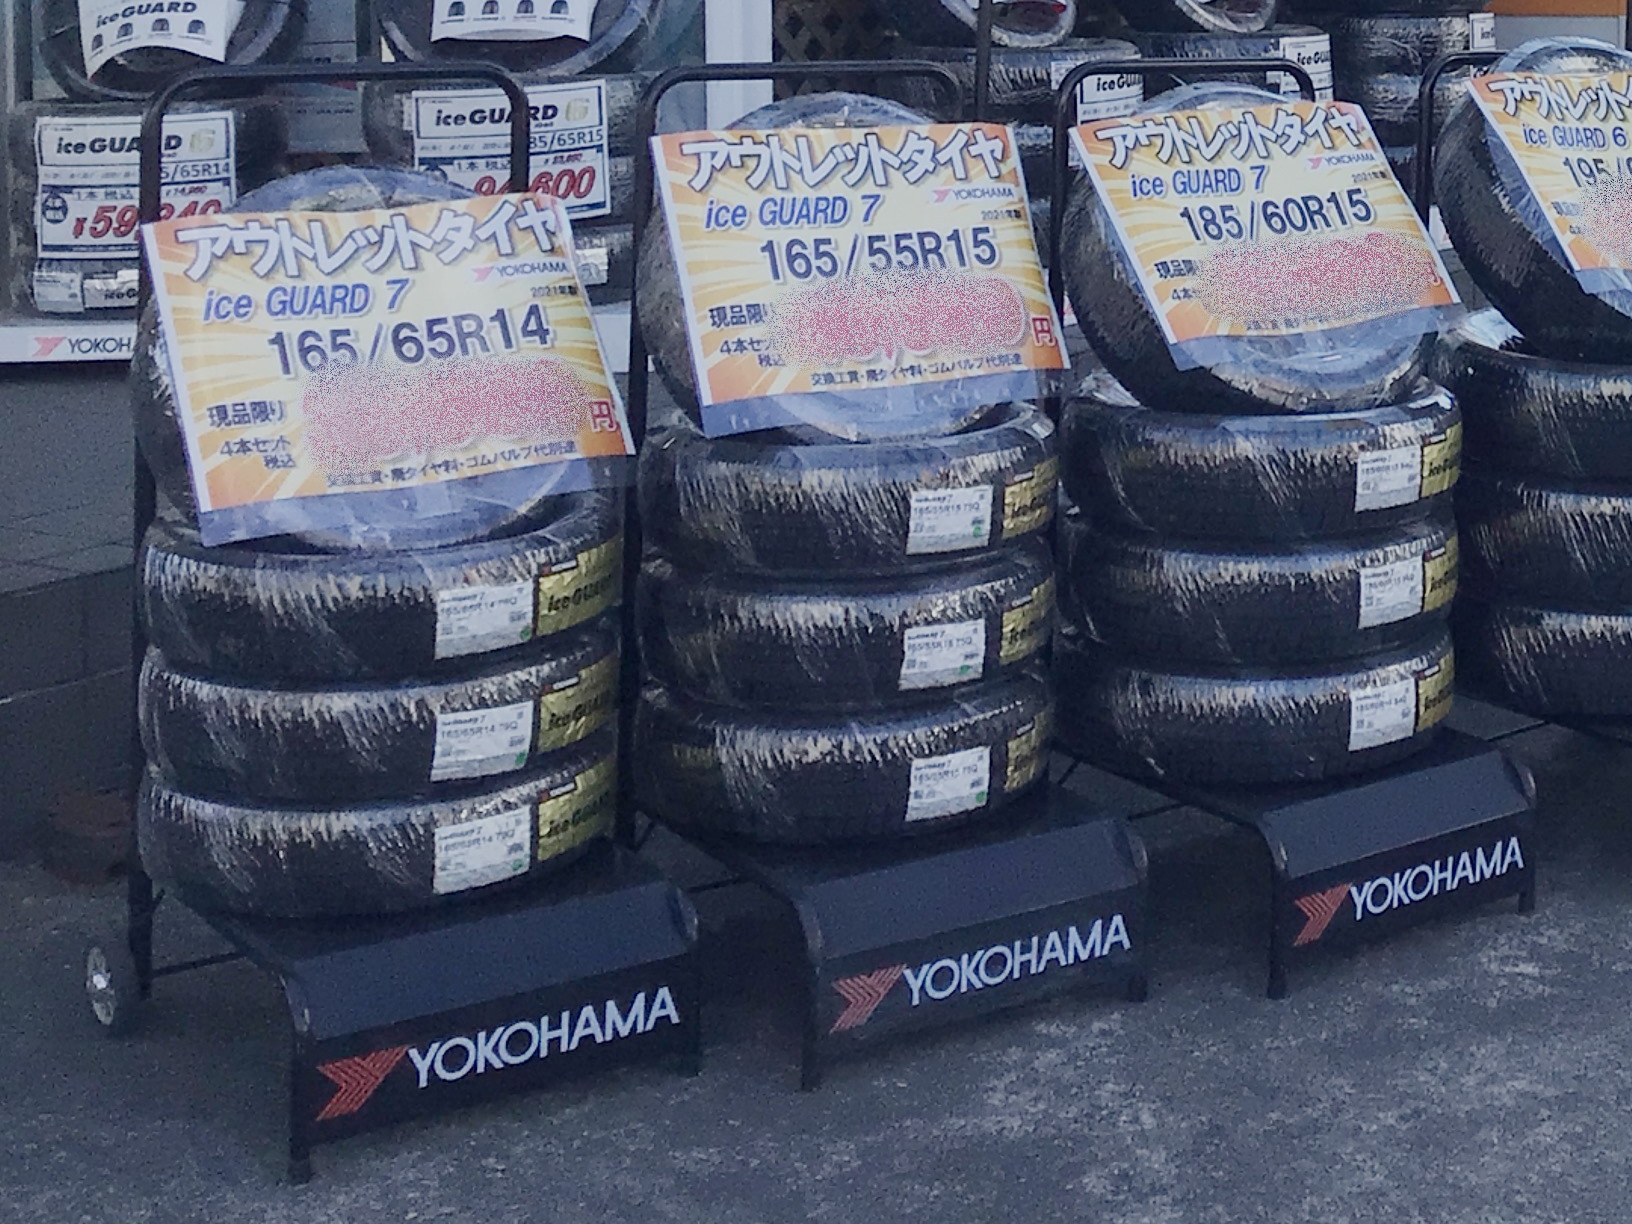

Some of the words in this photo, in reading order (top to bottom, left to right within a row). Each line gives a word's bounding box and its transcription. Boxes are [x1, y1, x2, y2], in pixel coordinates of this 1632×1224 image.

[56, 134, 183, 155] iceGUAD
[1095, 105, 1361, 169] アウトレットタイヤ
[1523, 124, 1548, 147] ice
[1552, 126, 1608, 150] GUARD
[1612, 126, 1628, 147] 6
[681, 128, 1005, 192] アウトレットタイヤ
[1324, 152, 1377, 169] YOKOHAMA
[951, 186, 1014, 201] YOKOHAMA
[1131, 172, 1165, 198] ice
[1172, 167, 1243, 196] GUARD
[1252, 164, 1268, 191] 7
[705, 200, 748, 230] ice
[759, 196, 849, 227] GUARD
[861, 194, 882, 223] 7
[1179, 187, 1373, 241] 185/60R15
[176, 198, 557, 282] アウトレットタイヤ
[760, 226, 998, 282] 165/55R15
[496, 260, 570, 278] YOKOHAMA
[204, 290, 252, 322] ice
[266, 281, 370, 318] GUARD
[386, 278, 409, 311] 7
[267, 303, 552, 376] 165/65R14
[1032, 316, 1056, 347] 円
[207, 400, 287, 429] 現品限り
[590, 399, 617, 433] 円
[1349, 836, 1524, 921] YOKOHAMA
[904, 913, 1132, 1007] YOKOHAMA
[410, 985, 681, 1089] YOKOHAMA
